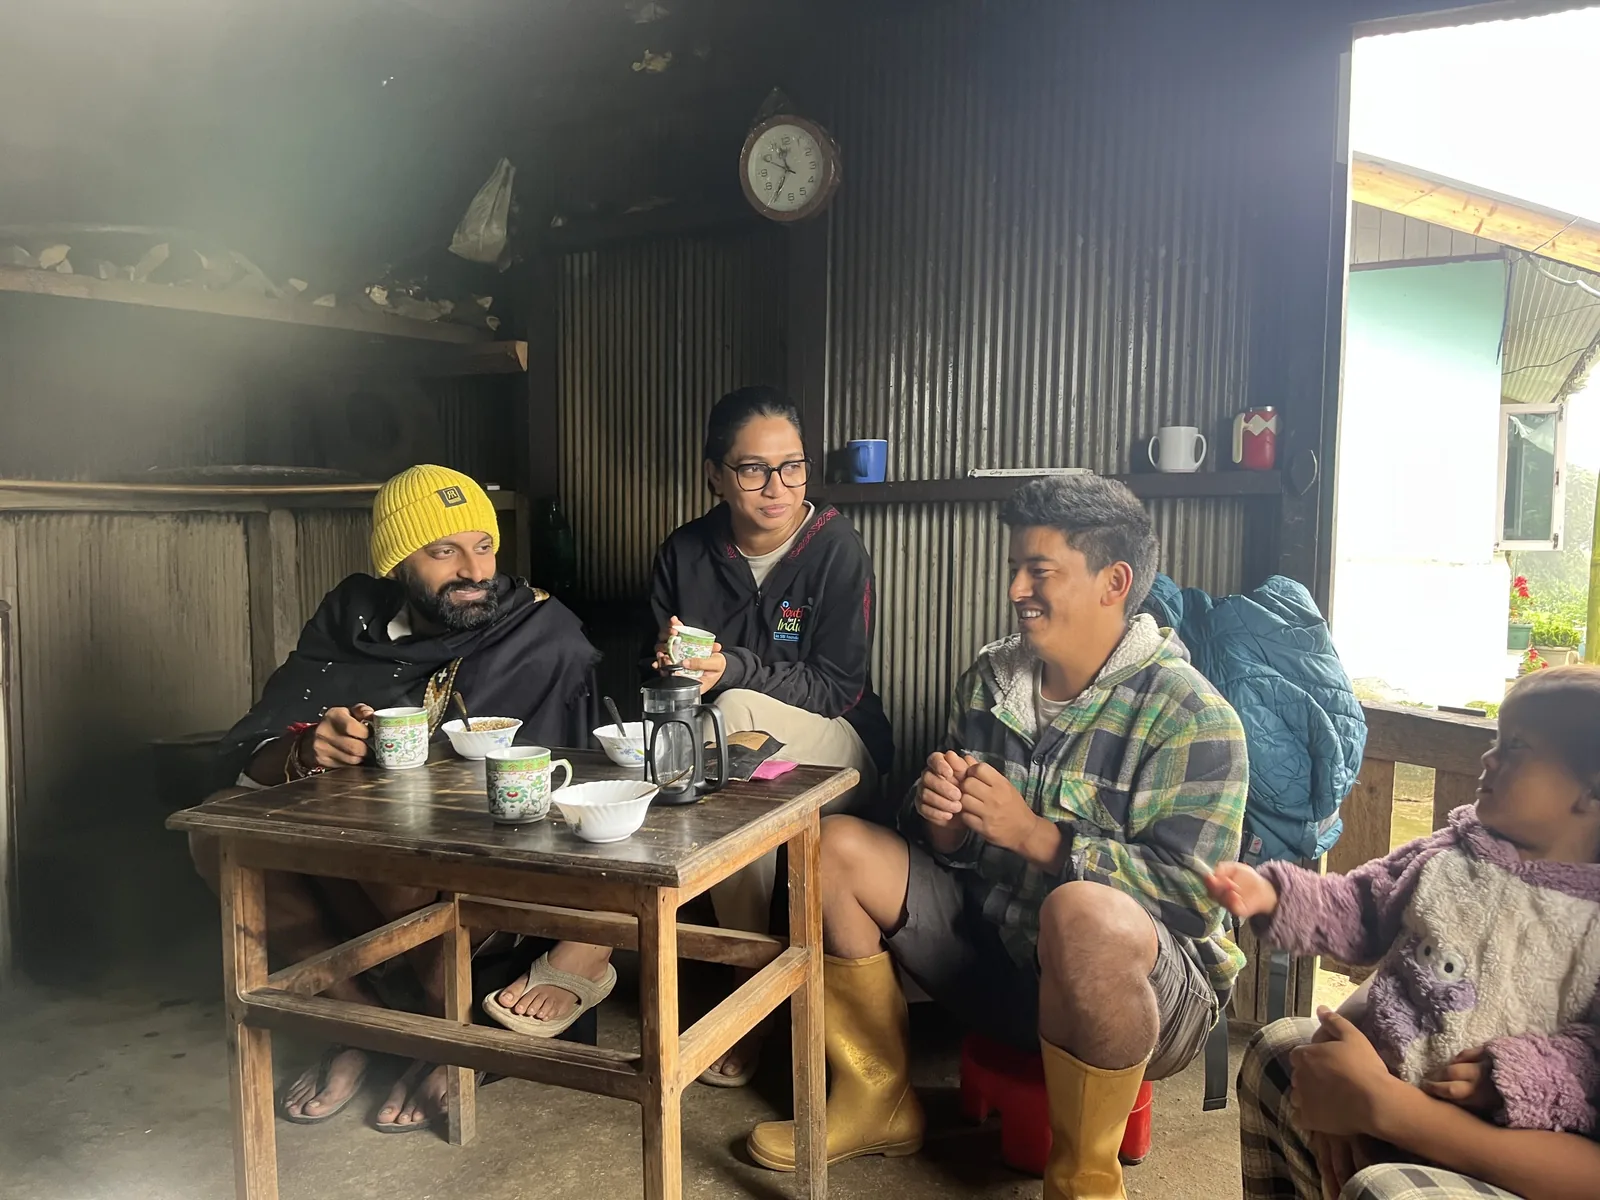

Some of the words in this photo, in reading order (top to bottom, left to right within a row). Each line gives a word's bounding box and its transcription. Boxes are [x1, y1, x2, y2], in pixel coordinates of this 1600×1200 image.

[781, 136, 791, 146] 12
[805, 147, 813, 157] 2
[809, 161, 817, 170] 3
[760, 168, 768, 178] 9
[807, 175, 814, 184] 4
[765, 182, 773, 191] 8
[799, 186, 808, 196] 5
[787, 192, 795, 202] 6
